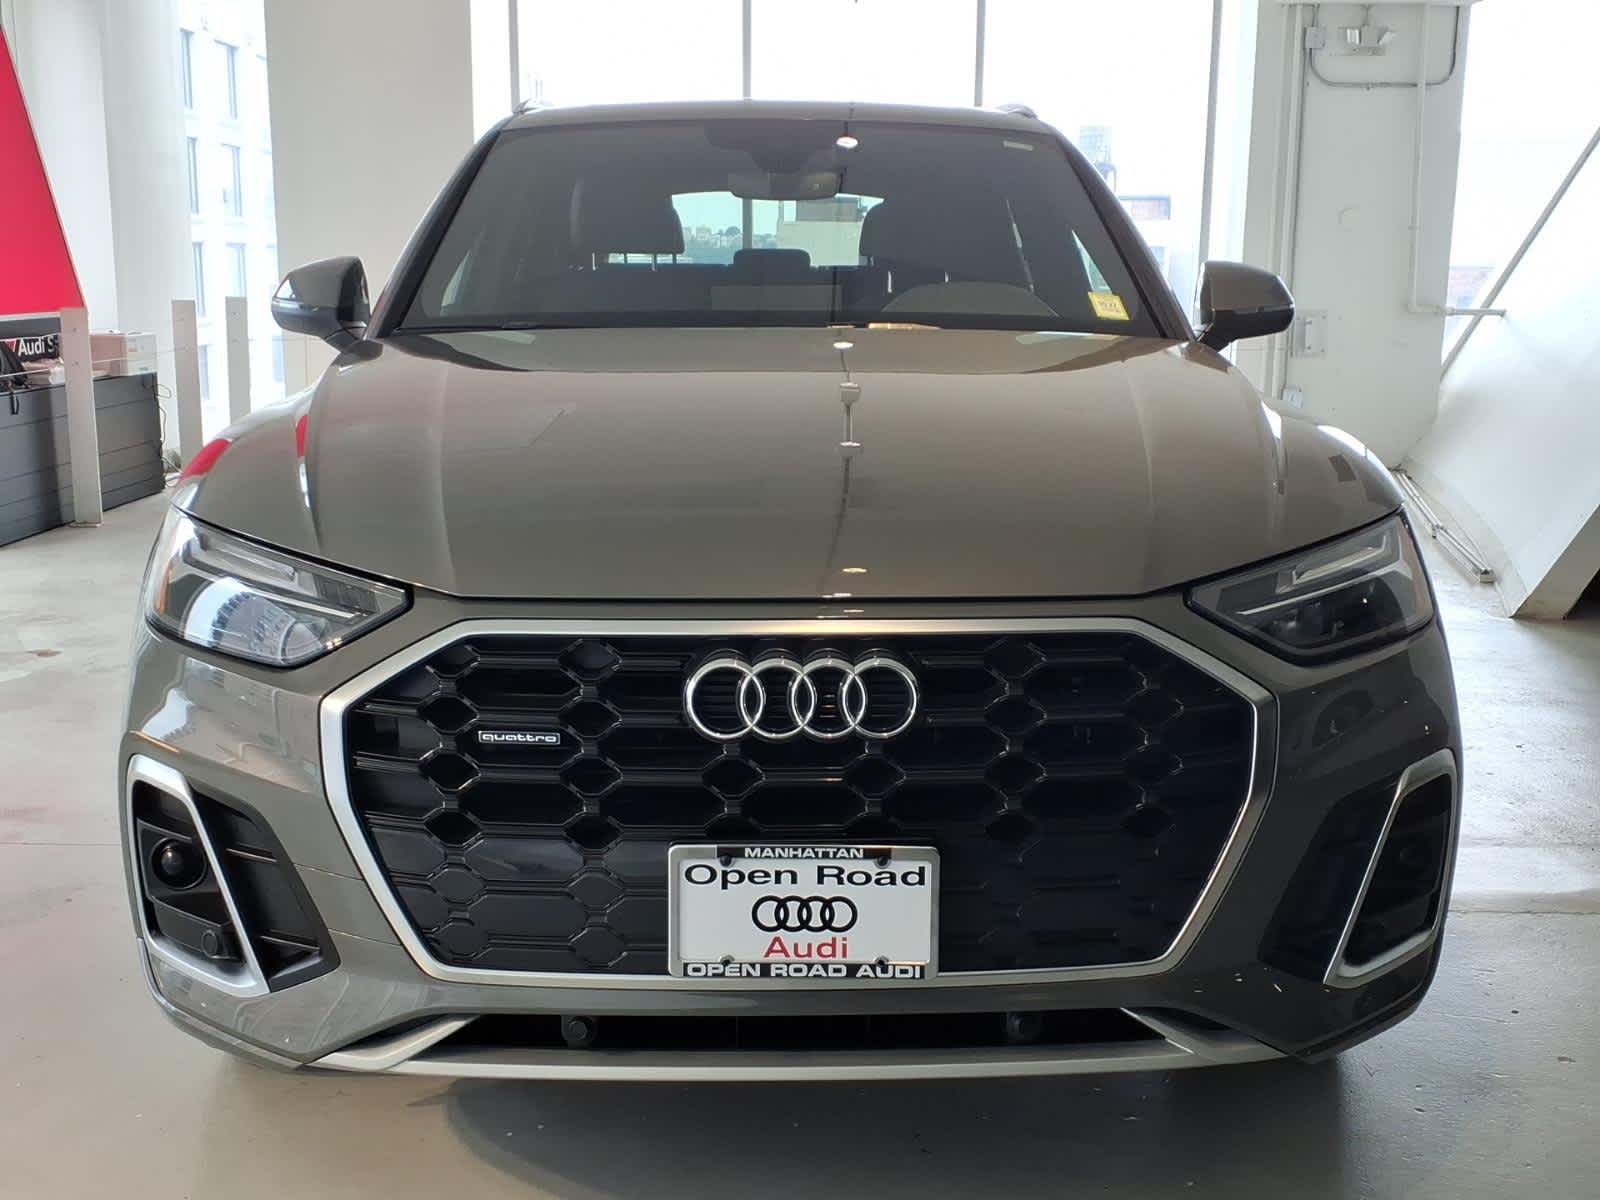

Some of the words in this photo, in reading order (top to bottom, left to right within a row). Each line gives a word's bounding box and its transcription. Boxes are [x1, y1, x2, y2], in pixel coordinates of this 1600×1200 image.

[18, 336, 46, 356] Audi
[482, 733, 557, 743] quattro
[744, 847, 864, 859] MANHATTAN
[684, 864, 798, 890] Open
[816, 865, 926, 887] Road
[763, 936, 848, 959] Audi
[687, 964, 761, 977] OPEN
[770, 964, 847, 977] ROAD
[855, 964, 921, 978] AUDI
